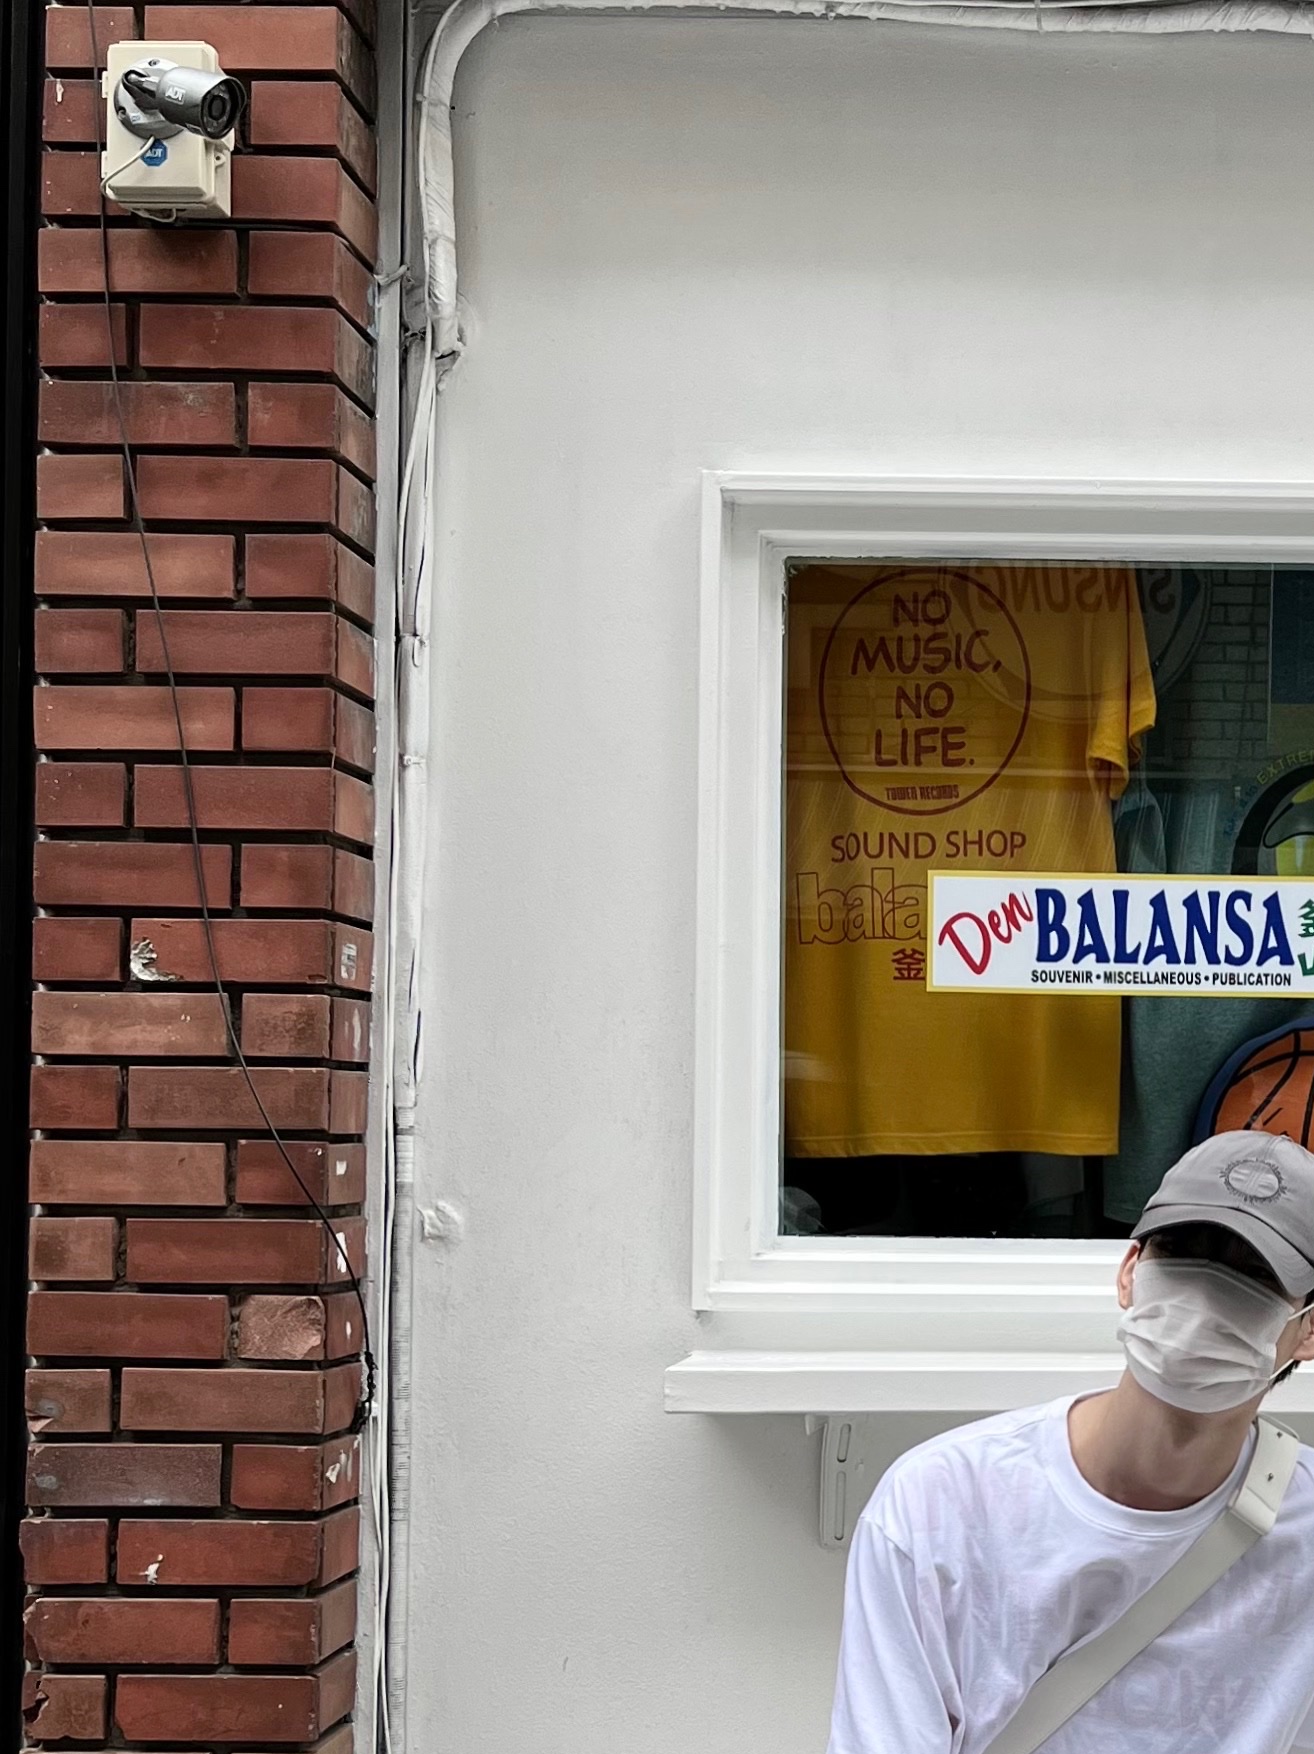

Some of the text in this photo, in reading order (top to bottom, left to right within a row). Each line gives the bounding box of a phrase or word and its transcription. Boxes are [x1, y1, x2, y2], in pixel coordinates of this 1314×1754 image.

[165, 85, 186, 102] ADT
[145, 148, 164, 158] ADT
[892, 590, 952, 628] NO
[850, 629, 1002, 676] MUSIC,
[895, 681, 954, 721] NO
[874, 726, 976, 768] LIFE.
[831, 829, 1027, 863] SOUND SHOP
[938, 887, 1295, 975] Den BALANSA
[1030, 969, 1292, 987] SOUVENIR MISCELLANEOUS PUBLICATION
